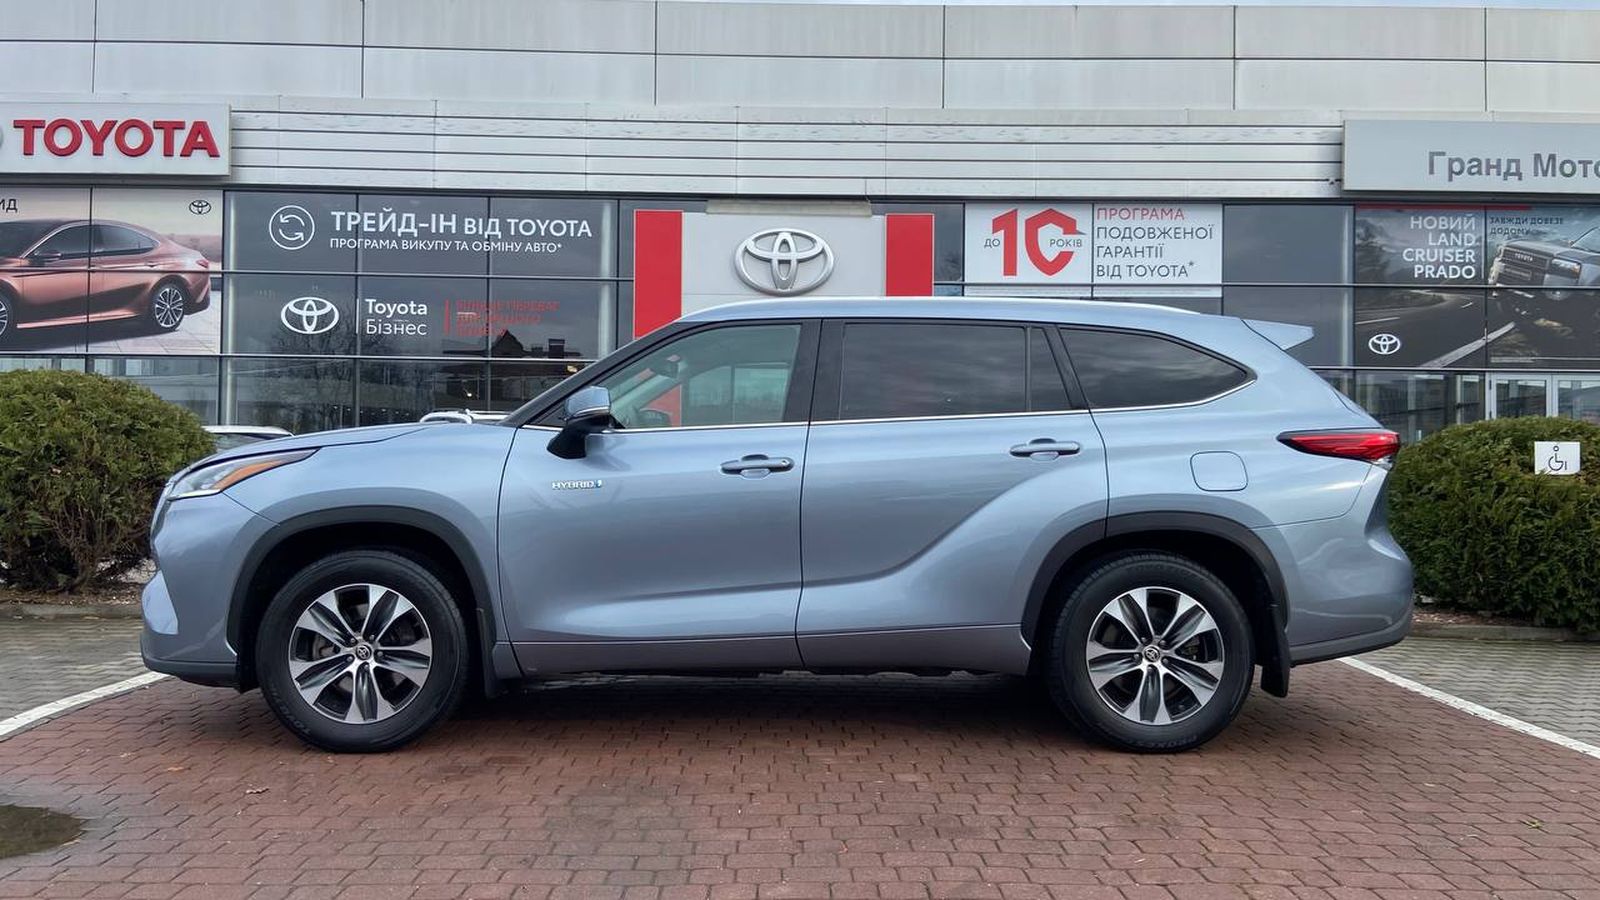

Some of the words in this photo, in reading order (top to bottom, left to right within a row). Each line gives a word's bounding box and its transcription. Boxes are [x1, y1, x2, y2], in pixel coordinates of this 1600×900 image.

[13, 118, 221, 157] TOYOTA
[1428, 151, 1523, 182] Гранд
[1097, 207, 1185, 220] ПРОГРАМА
[330, 207, 457, 237] ТРЕЙД-ІН
[464, 218, 502, 239] ВІД
[506, 218, 592, 237] TOYOTA
[1410, 213, 1476, 230] НОВИЙ
[1097, 224, 1215, 241] ПОДОВЖЕНОЇ
[1428, 233, 1476, 246] LAND
[330, 238, 399, 250] ПРОГРАМА
[402, 240, 452, 251] ВИКУПУ
[454, 241, 469, 251] ТА
[472, 241, 522, 252] ОБМІНУ
[984, 238, 1001, 249] ДО
[991, 208, 1078, 276] 10
[1050, 239, 1083, 248] РОКІВ
[1096, 243, 1165, 258] ГАРАНТІЇ
[1402, 247, 1476, 263] CRUISER
[1096, 265, 1122, 279] ВІД
[1414, 264, 1476, 279] PRADO
[365, 298, 428, 318] Toyota
[366, 319, 427, 335] Бізнес
[552, 480, 595, 489] HYBRID
